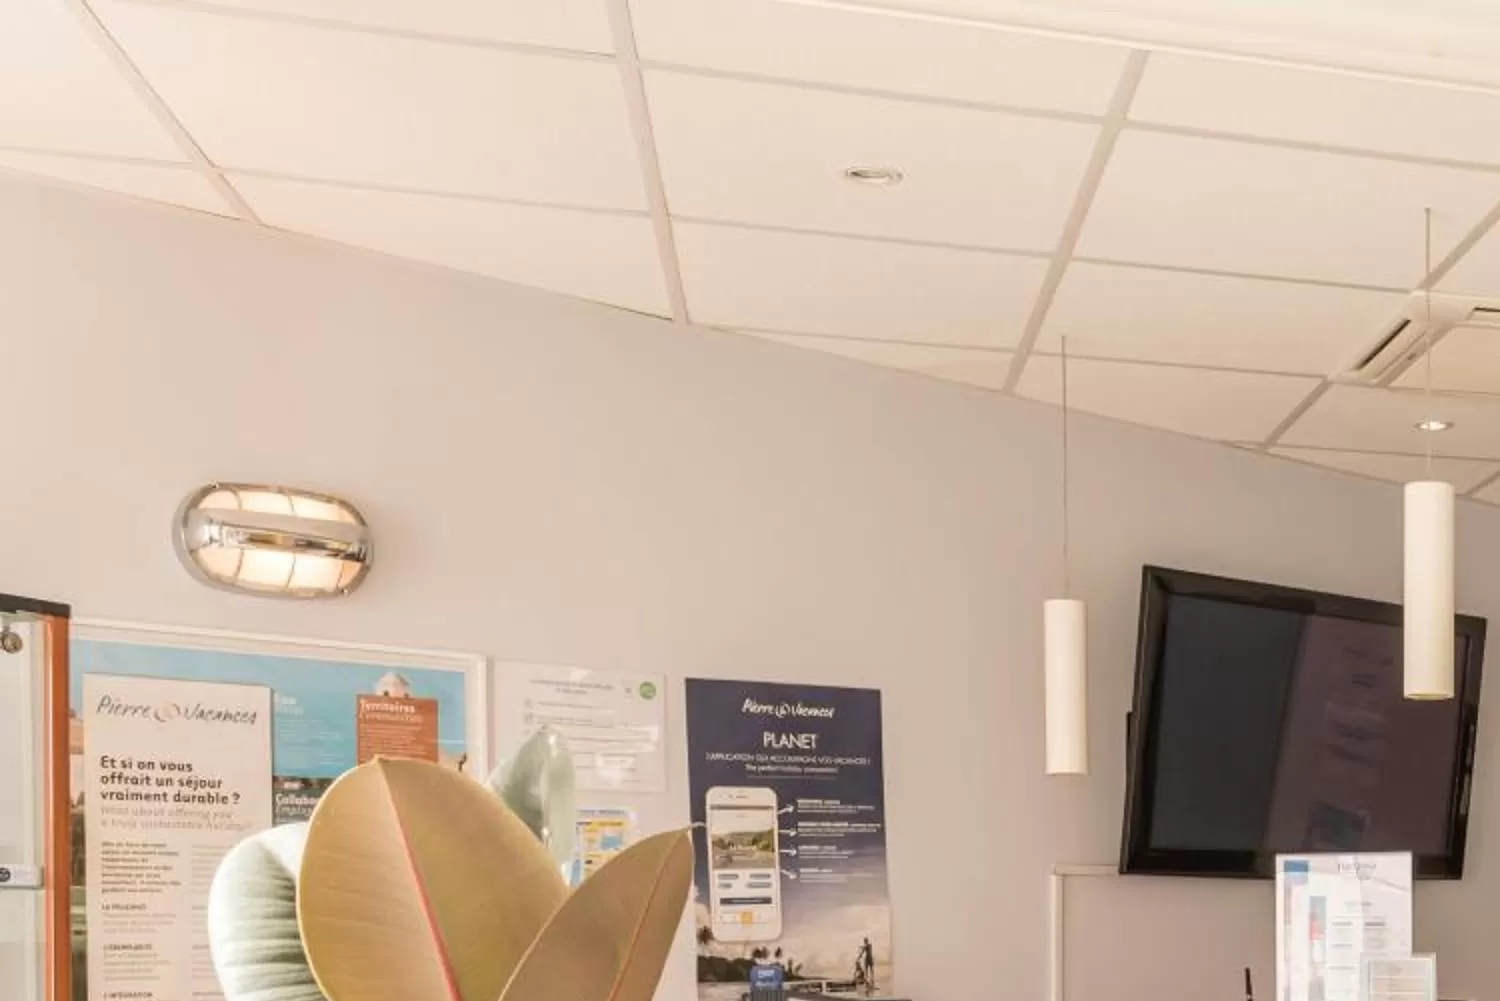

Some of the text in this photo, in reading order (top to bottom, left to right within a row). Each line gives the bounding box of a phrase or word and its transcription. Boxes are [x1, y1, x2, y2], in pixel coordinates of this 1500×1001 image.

[96, 694, 153, 719] Pierre
[183, 702, 258, 726] Vacances
[762, 730, 818, 750] PLANET
[100, 755, 193, 773] Et si on vous
[100, 772, 224, 791] offrait un séjour
[100, 788, 242, 805] vraiment durable ?
